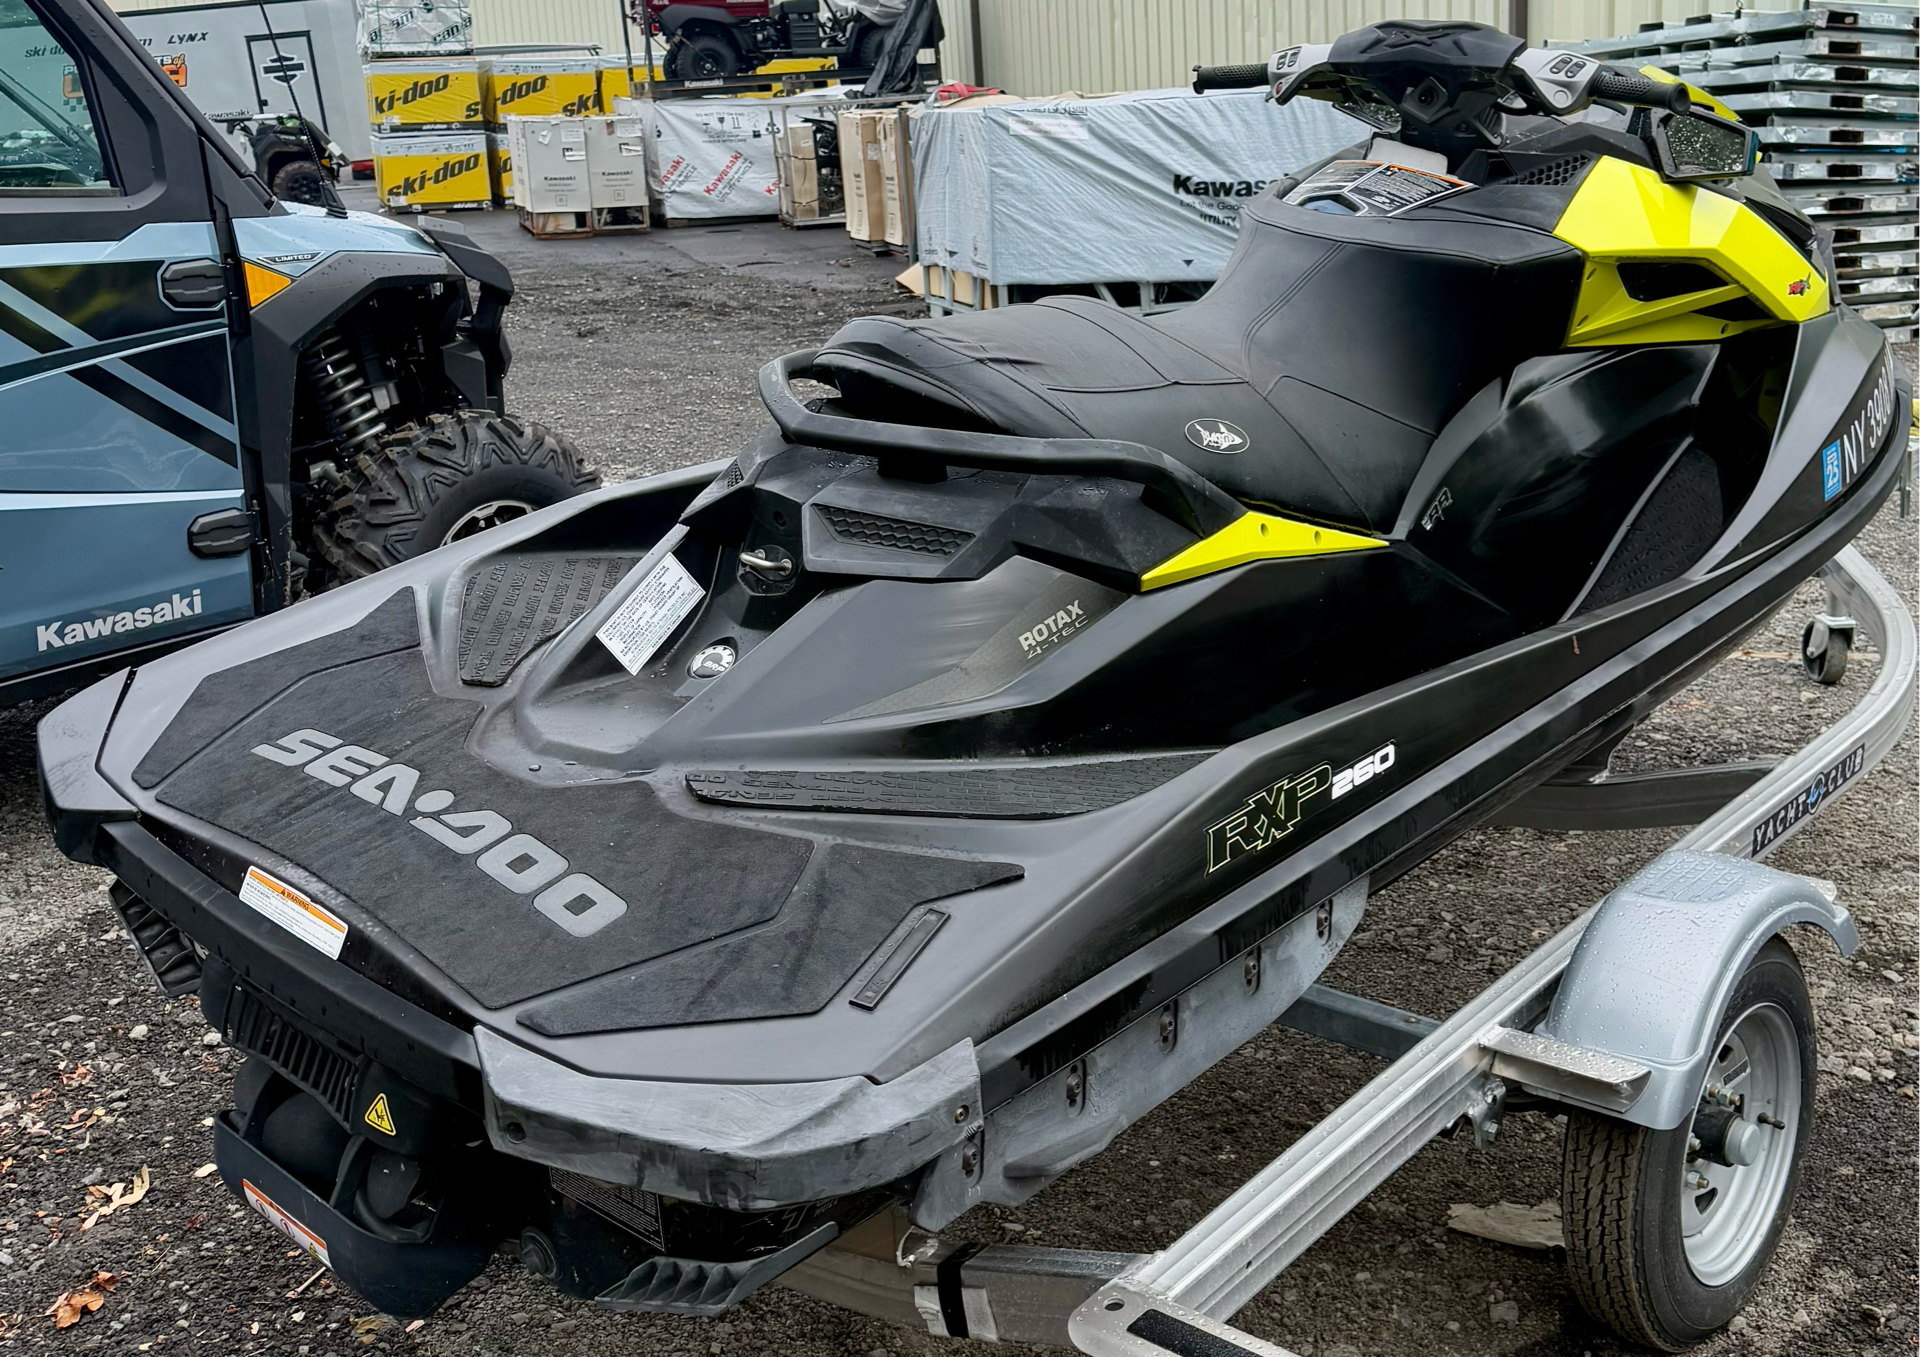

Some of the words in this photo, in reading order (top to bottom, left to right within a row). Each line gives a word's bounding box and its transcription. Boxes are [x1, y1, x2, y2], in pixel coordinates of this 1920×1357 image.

[167, 31, 209, 45] LYNX
[685, 79, 723, 88] Kawasaki
[387, 153, 480, 204] ski-doo
[703, 150, 743, 196] Kawasaki
[275, 254, 312, 262] LIMITED
[1843, 409, 1866, 484] NY
[1826, 460, 1839, 489] 25
[36, 589, 202, 652] Kawasaki
[1018, 599, 1084, 651] ROTAX
[1027, 615, 1089, 660] 4-TEC
[703, 660, 726, 672] BRP
[1206, 762, 1332, 874] RXP
[1331, 744, 1395, 800] 260
[1755, 792, 1806, 851] YACHT
[1827, 747, 1863, 793] CLUB
[286, 891, 310, 911] WARNING
